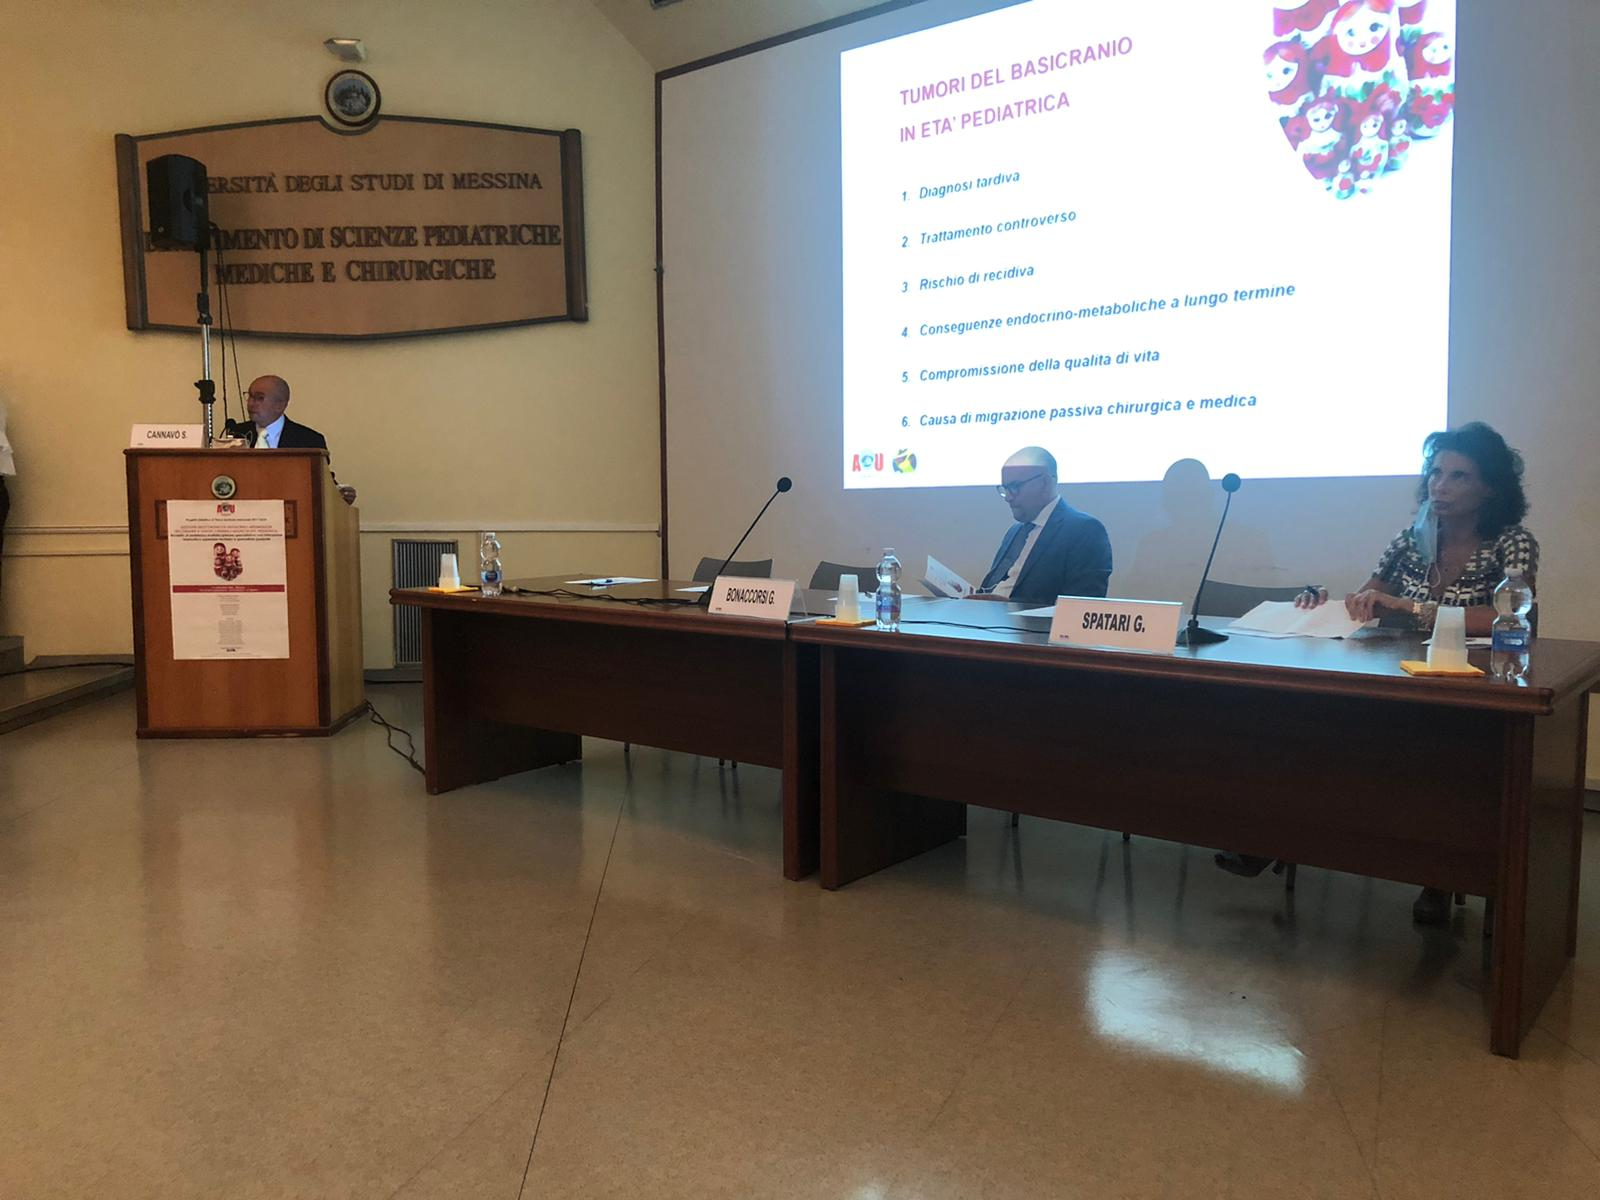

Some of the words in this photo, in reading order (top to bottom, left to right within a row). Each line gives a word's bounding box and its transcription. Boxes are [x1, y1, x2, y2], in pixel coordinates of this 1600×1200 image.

[899, 77, 966, 106] TUMORI
[970, 69, 1005, 90] DEL
[1010, 36, 1133, 81] BASICRANIO
[900, 126, 916, 143] IN
[961, 92, 1070, 130] PEDIATRICA
[206, 171, 279, 194] ERSITÀ
[285, 174, 343, 193] DEGLI
[351, 172, 415, 192] STUDI
[423, 172, 445, 190] DI
[452, 171, 543, 190] MESSINA
[918, 179, 973, 200] Diagnosi
[976, 171, 1021, 189] tardiva
[303, 226, 325, 250] DI
[330, 225, 418, 249] SCIENZE
[423, 223, 563, 247] PEDIATRICHE
[920, 224, 993, 245] Trattamento
[996, 210, 1077, 233] controverso
[322, 261, 336, 283] E
[346, 257, 497, 283] CHIRURGICHE
[919, 275, 965, 291] Rischio
[967, 271, 981, 285] di
[983, 264, 1035, 283] recidiva
[919, 317, 1003, 337] Conseguenze
[1005, 296, 1167, 327] endocrino-metaboliche
[1170, 297, 1180, 309] a
[1183, 291, 1229, 310] lungo
[1233, 282, 1296, 303] termine
[919, 362, 1026, 383] Compromissione
[1028, 357, 1061, 374] della
[1115, 350, 1130, 365] di
[1133, 349, 1161, 364] vita
[919, 414, 958, 428] Causa
[959, 411, 973, 425] di
[974, 406, 1047, 426] migrazione
[1048, 403, 1104, 422] passiva
[1106, 398, 1183, 418] chirurgica
[1185, 399, 1196, 411] e
[1199, 393, 1258, 410] medica
[726, 587, 769, 604] BONACCORSI
[769, 590, 775, 605] G.
[1082, 612, 1131, 632] SPATARI
[1133, 615, 1146, 633] G.
